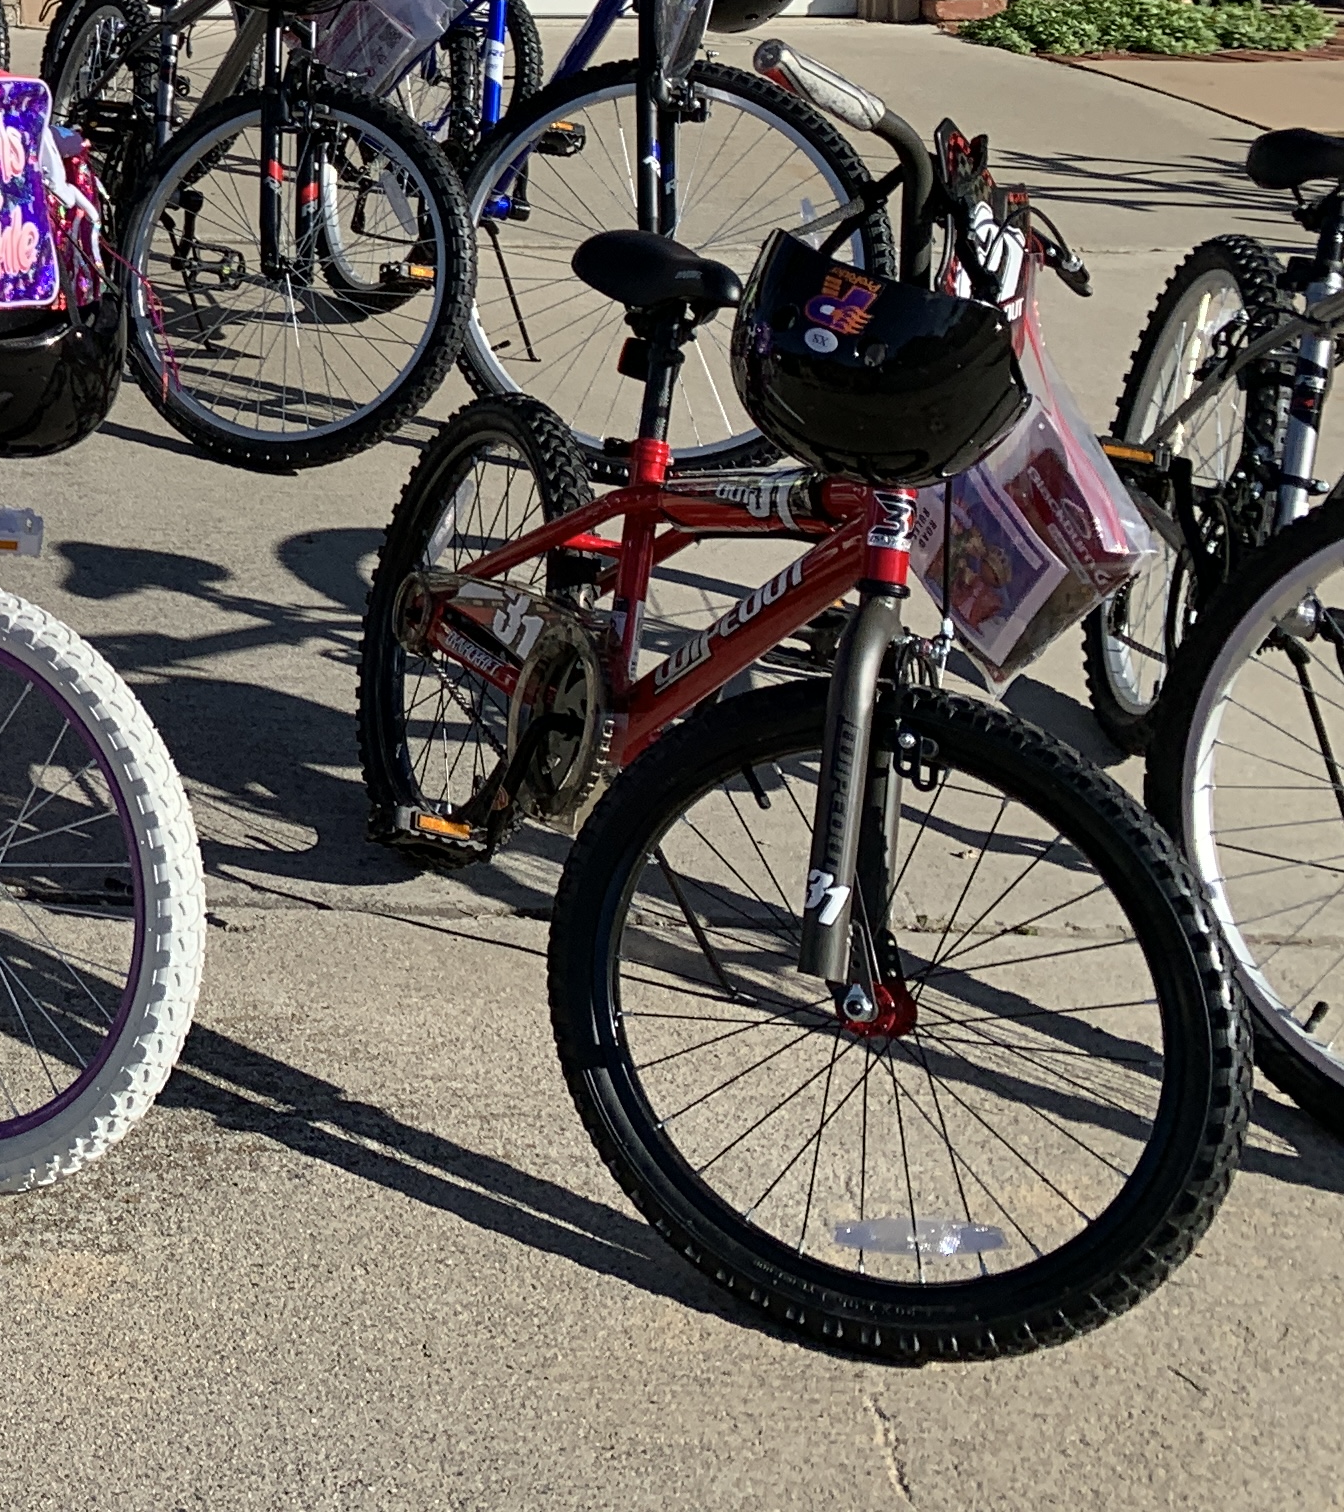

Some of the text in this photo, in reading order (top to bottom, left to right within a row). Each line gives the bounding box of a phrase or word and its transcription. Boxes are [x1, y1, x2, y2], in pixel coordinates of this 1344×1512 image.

[918, 518, 938, 549] ROAD
[493, 588, 545, 660] 31
[654, 558, 806, 695] WIPEOUT
[805, 869, 851, 926] 31
